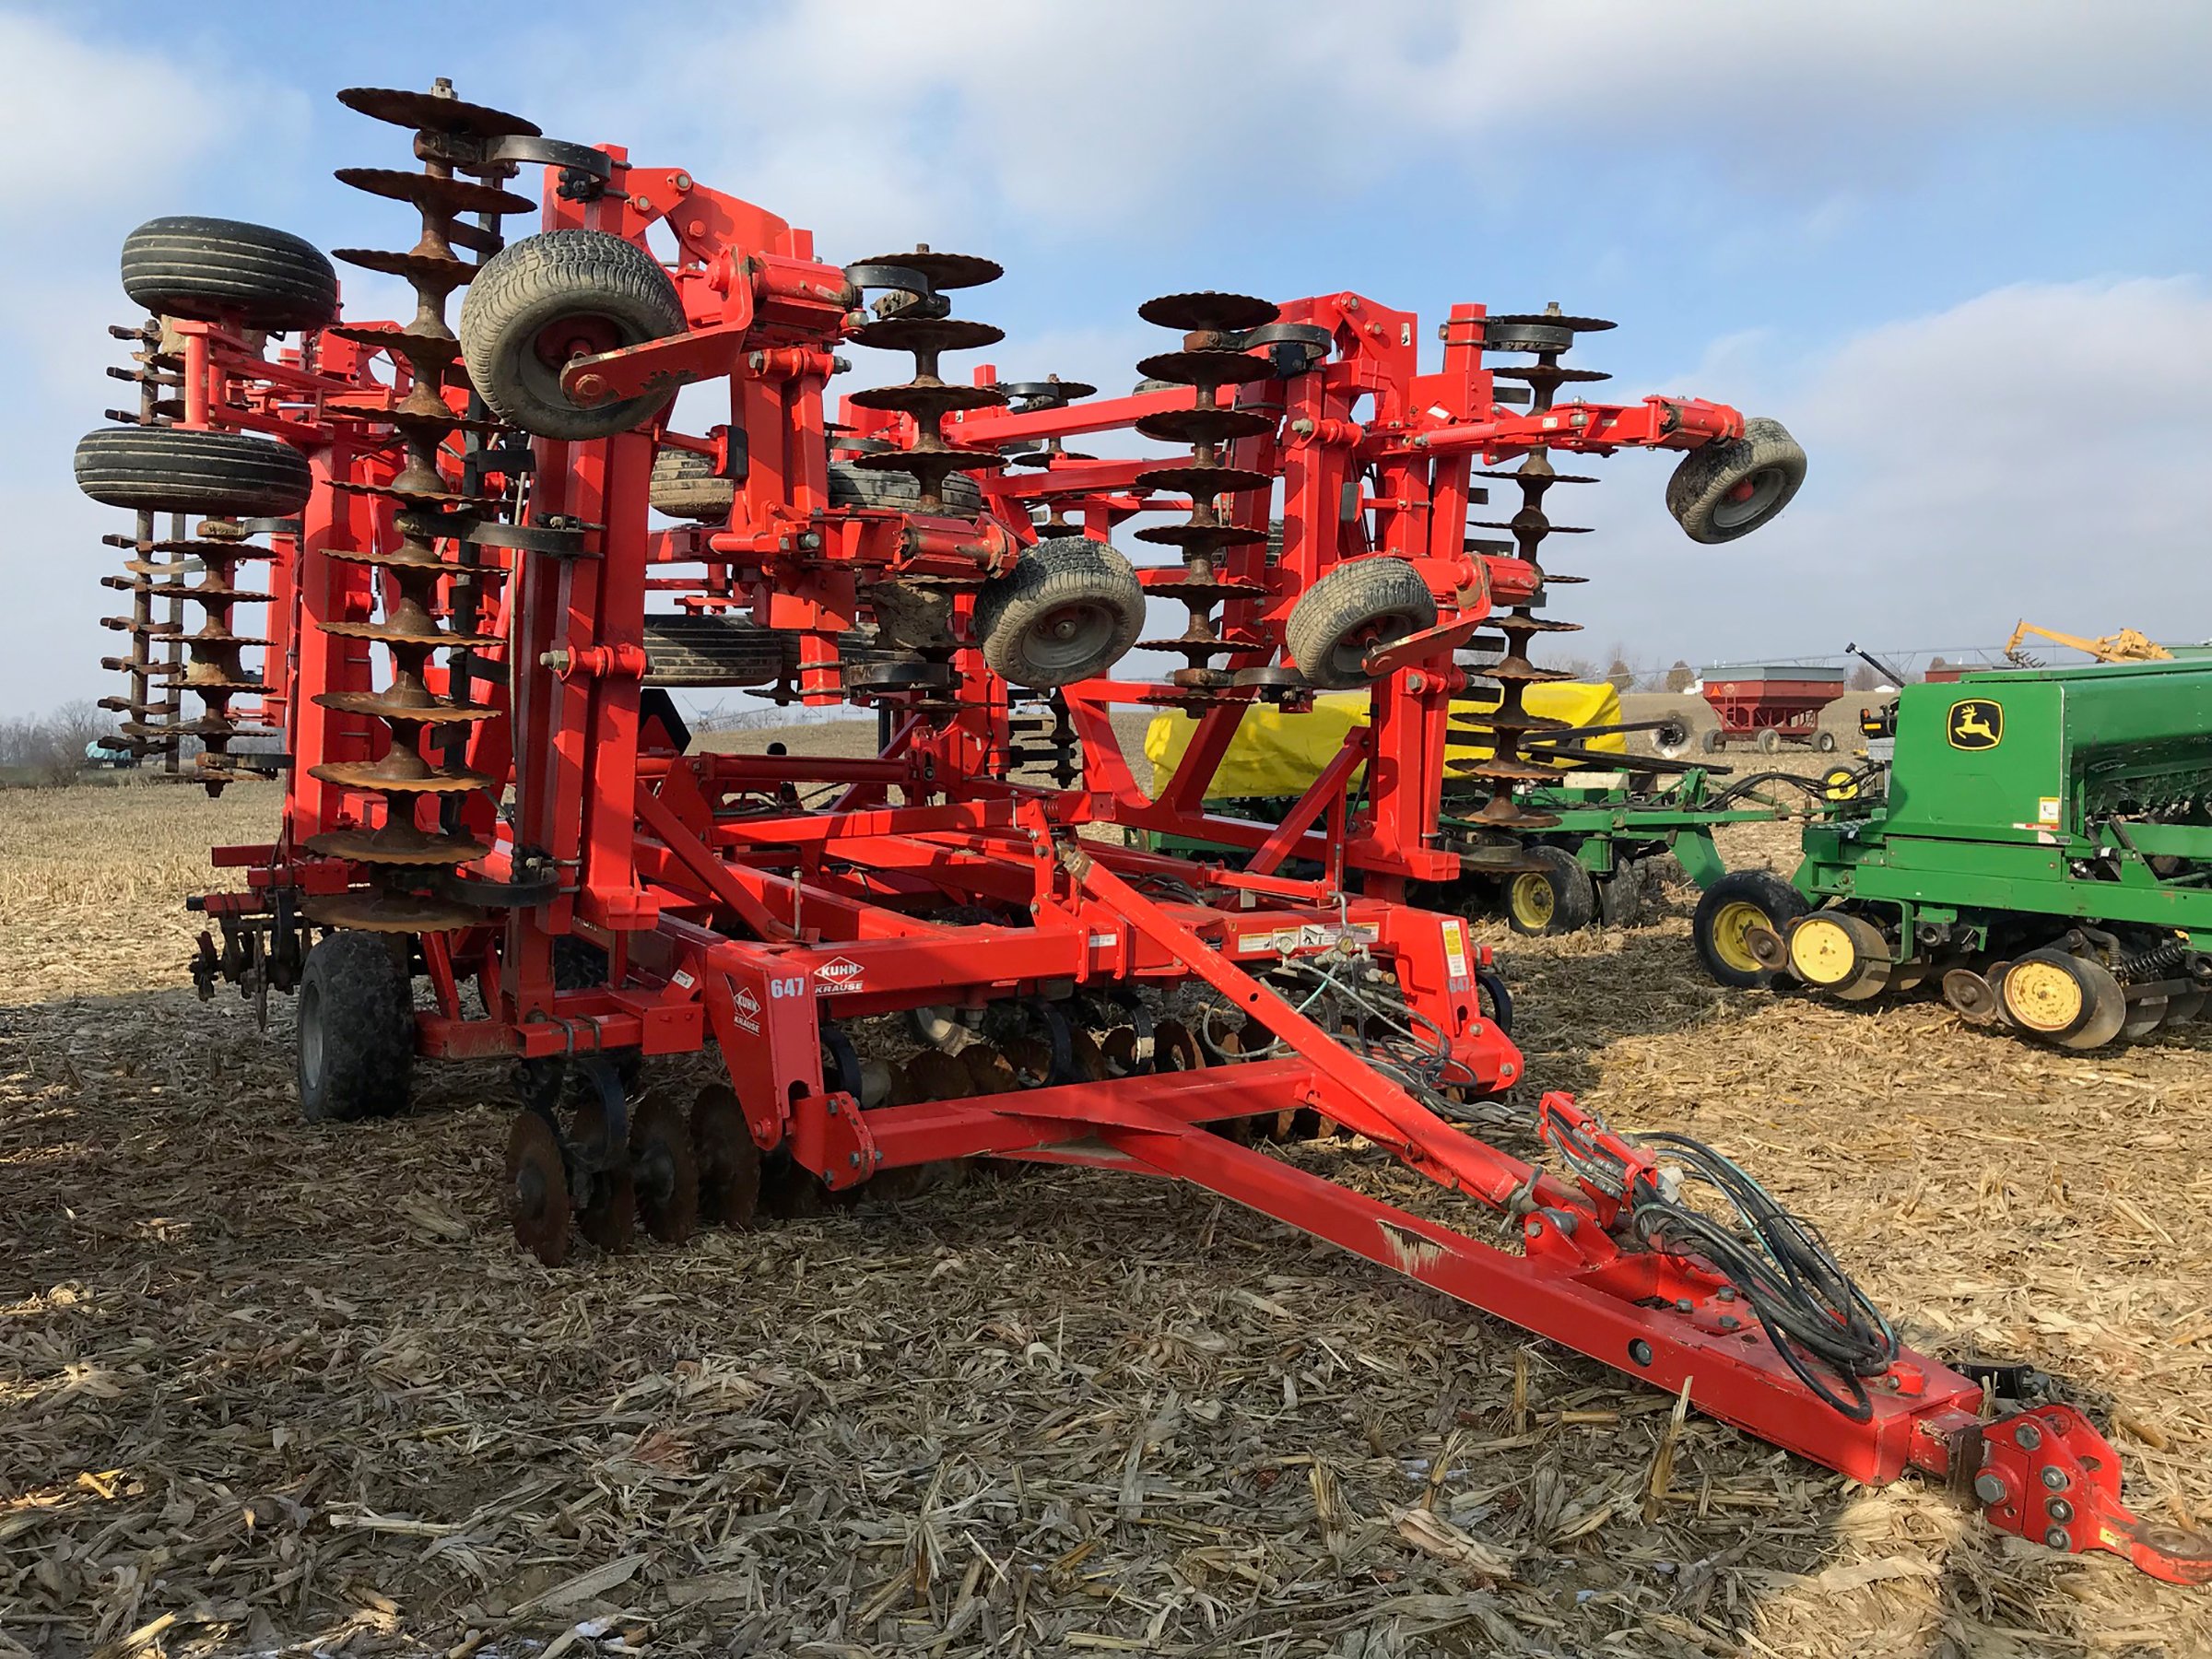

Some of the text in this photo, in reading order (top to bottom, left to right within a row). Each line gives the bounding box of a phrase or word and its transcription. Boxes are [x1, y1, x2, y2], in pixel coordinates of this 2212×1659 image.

[821, 965, 857, 977] KUHN
[771, 977, 805, 999] 647
[815, 982, 864, 994] KRAUSE
[1448, 976, 1470, 994] 647
[736, 994, 758, 1013] KUHN
[734, 1015, 760, 1034] KRAUSE
